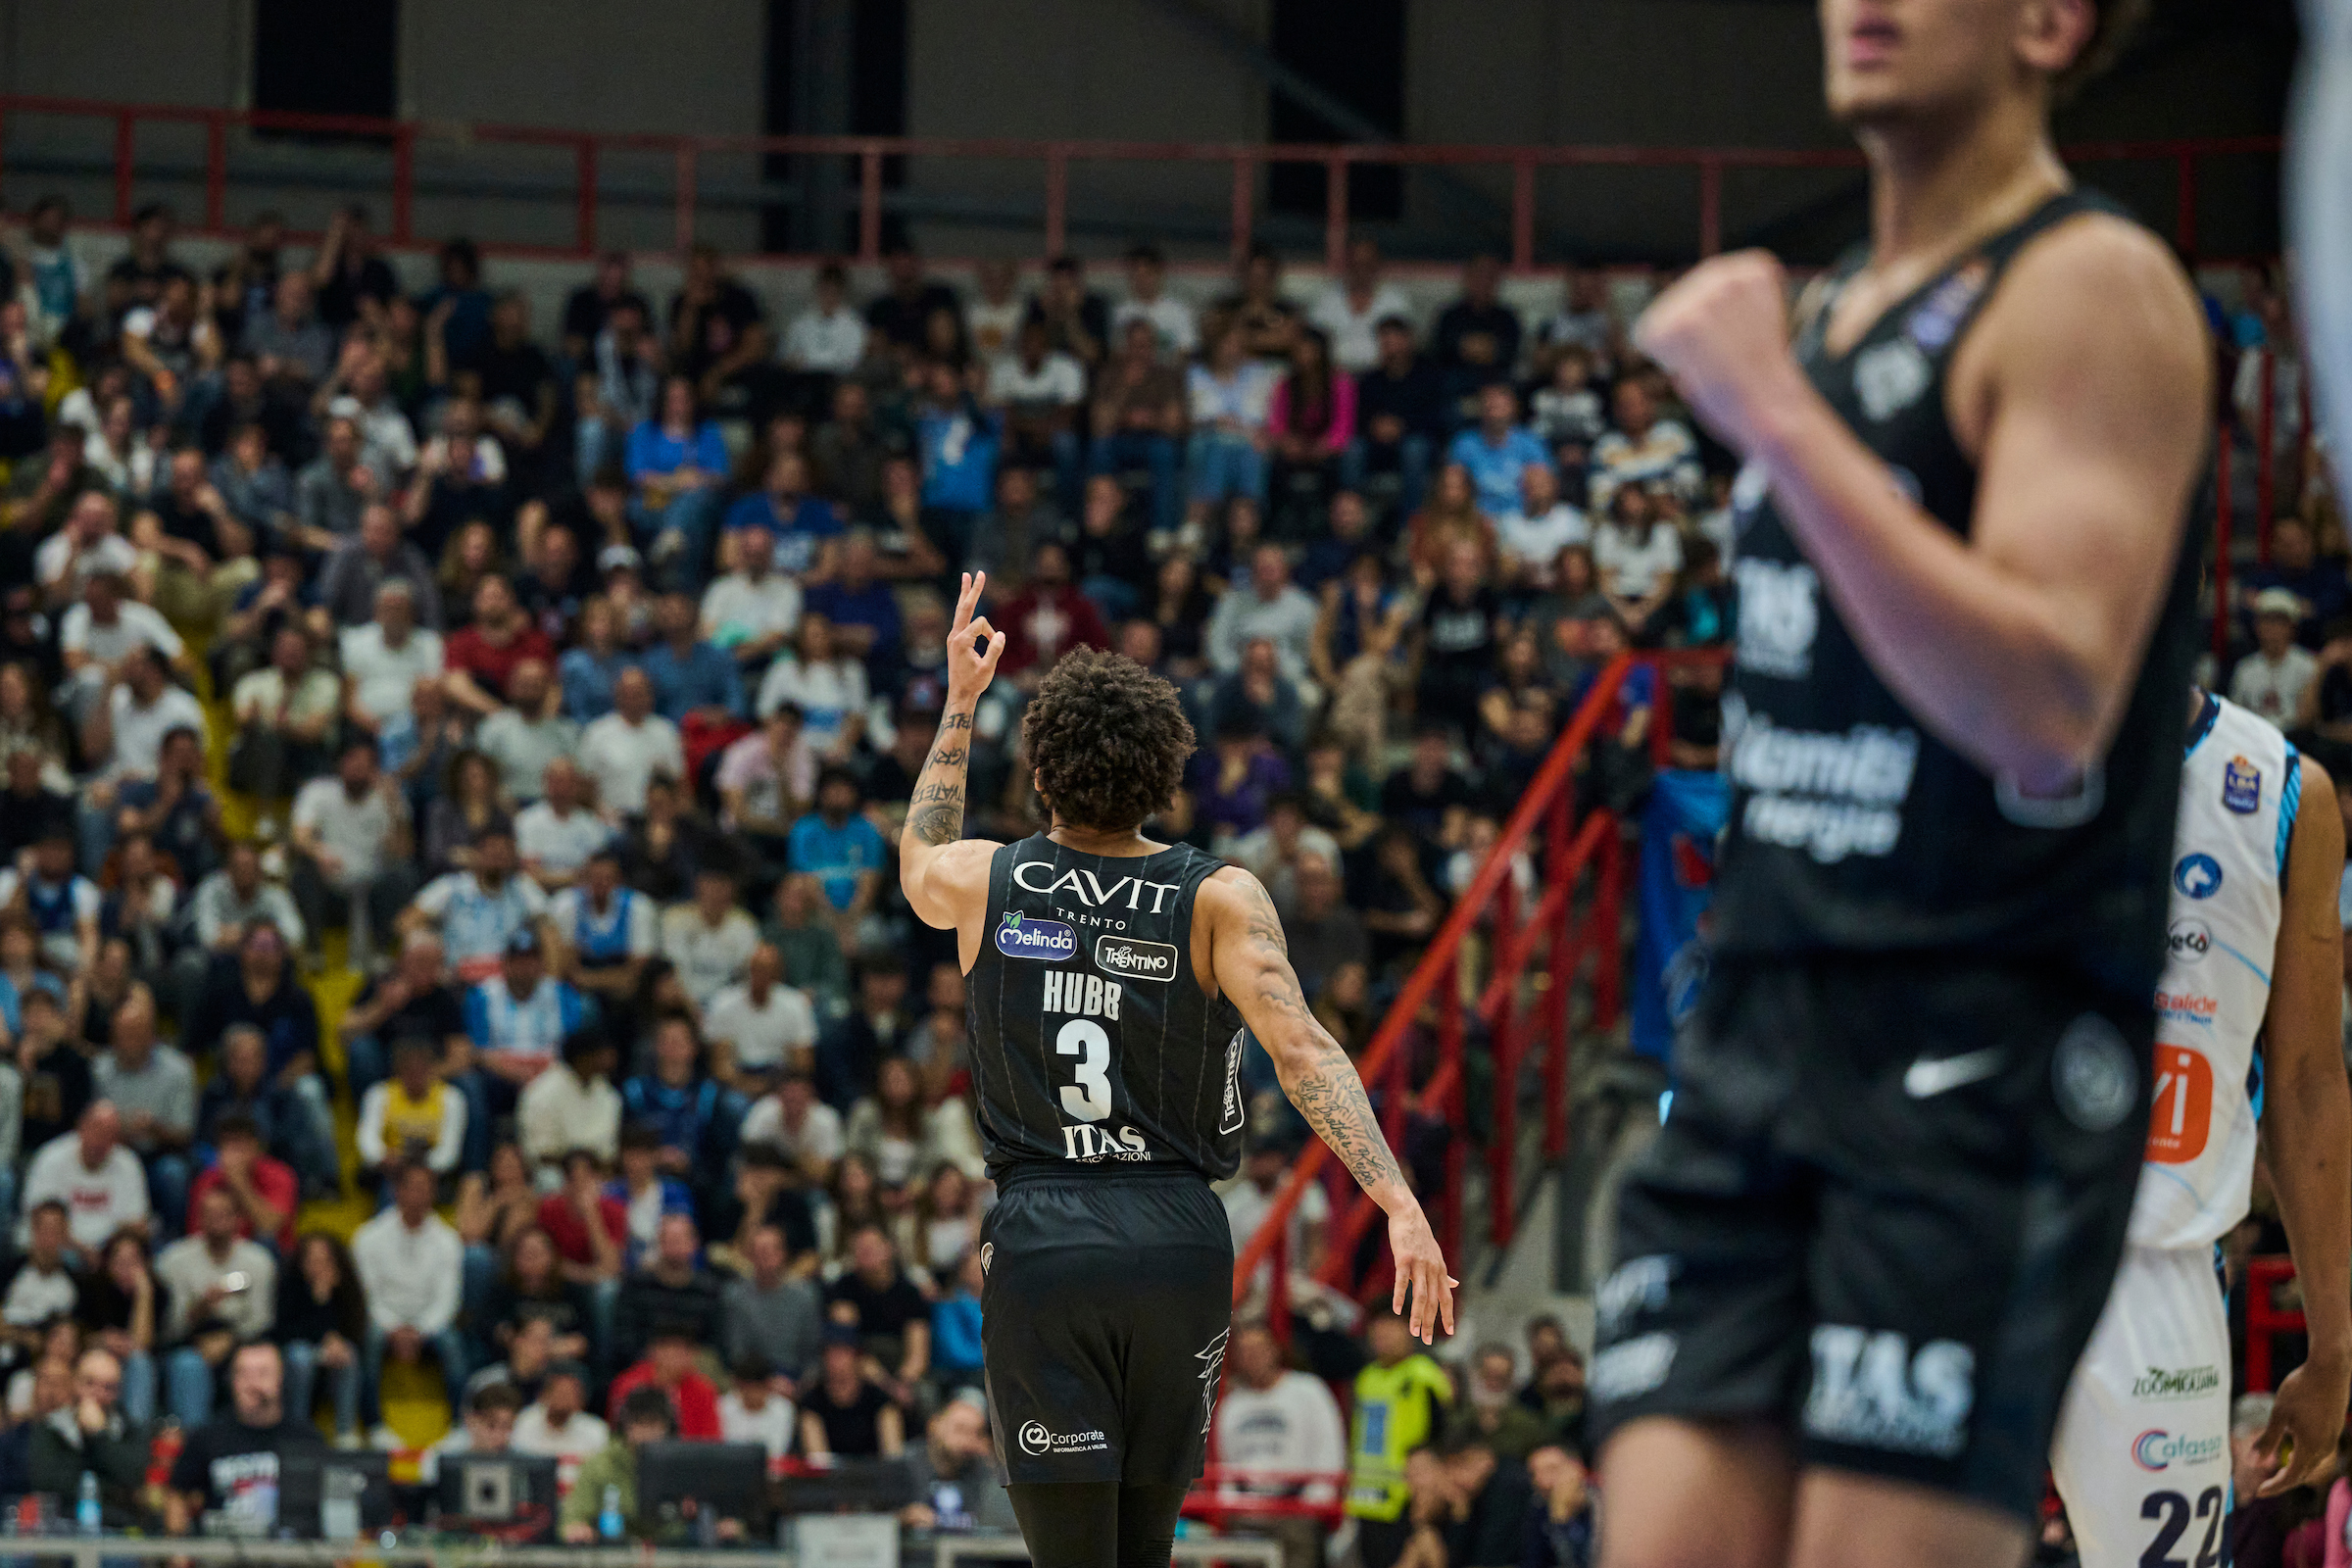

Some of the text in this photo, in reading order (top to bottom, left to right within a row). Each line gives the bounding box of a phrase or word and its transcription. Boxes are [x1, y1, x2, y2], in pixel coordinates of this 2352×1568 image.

[1012, 861, 1180, 913] CAVIT
[1056, 907, 1126, 930] TRENTO
[1104, 946, 1168, 971] TRENTINO
[1044, 970, 1122, 1021] HUBB
[1055, 1019, 1112, 1122] 3
[1224, 1042, 1237, 1121] TRENTINO
[1061, 1124, 1146, 1159] ITAS
[1051, 1430, 1104, 1446] Corporate
[2139, 1485, 2223, 1568] 22
